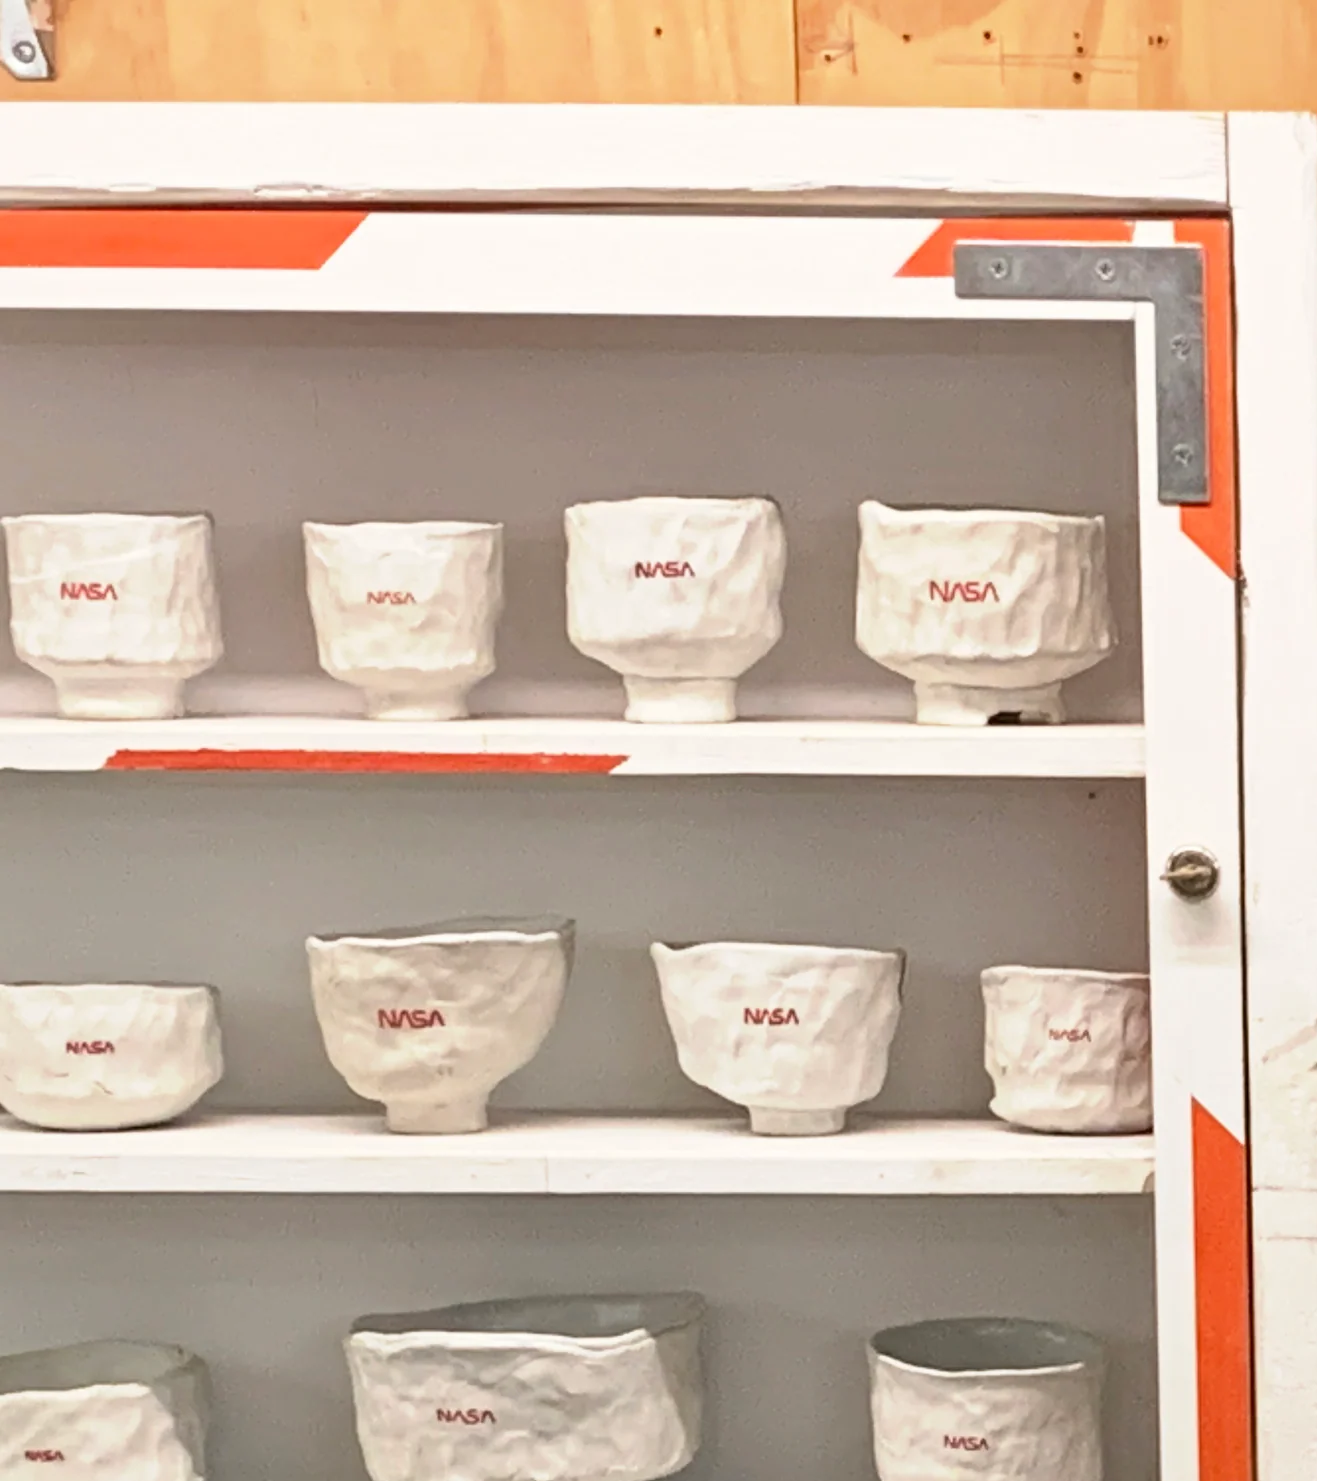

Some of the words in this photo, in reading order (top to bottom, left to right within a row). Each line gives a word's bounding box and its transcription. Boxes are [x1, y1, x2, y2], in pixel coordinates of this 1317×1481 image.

[633, 561, 696, 579] NASA
[59, 581, 119, 601] NASA
[367, 590, 417, 606] NASA
[928, 579, 1001, 604] NASA
[377, 1008, 447, 1029] NASA
[743, 1007, 800, 1027] NASA
[1050, 1028, 1092, 1043] NASA
[65, 1040, 116, 1055] NASA
[435, 1408, 497, 1426] NASA
[943, 1434, 988, 1451] NASA
[23, 1449, 66, 1463] NASA
